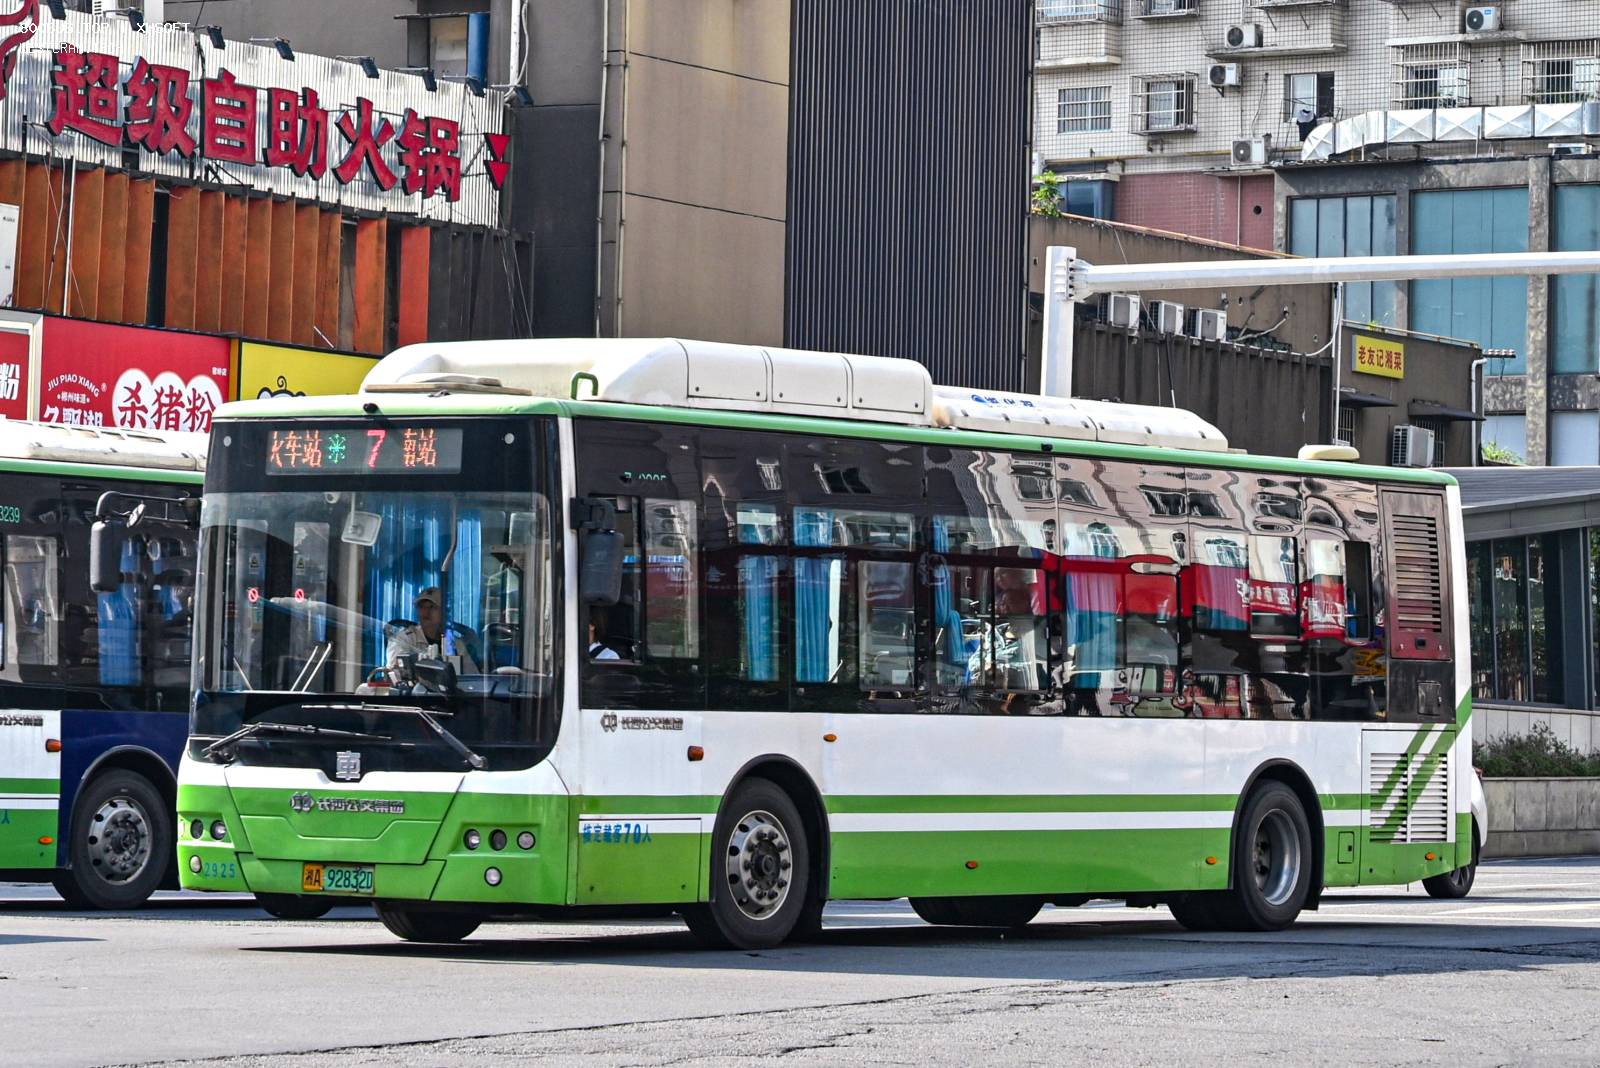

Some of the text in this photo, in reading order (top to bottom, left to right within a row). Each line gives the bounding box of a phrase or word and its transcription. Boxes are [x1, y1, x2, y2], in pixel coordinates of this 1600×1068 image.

[46, 49, 461, 203] 超级自助火锅
[1358, 345, 1402, 371] 老友记湘菜
[47, 373, 101, 398] JIU PIAO XIANG
[117, 380, 217, 434] 杀猪粉
[367, 429, 386, 468] 7
[203, 862, 236, 878] 2925
[327, 868, 374, 889] 92832D
